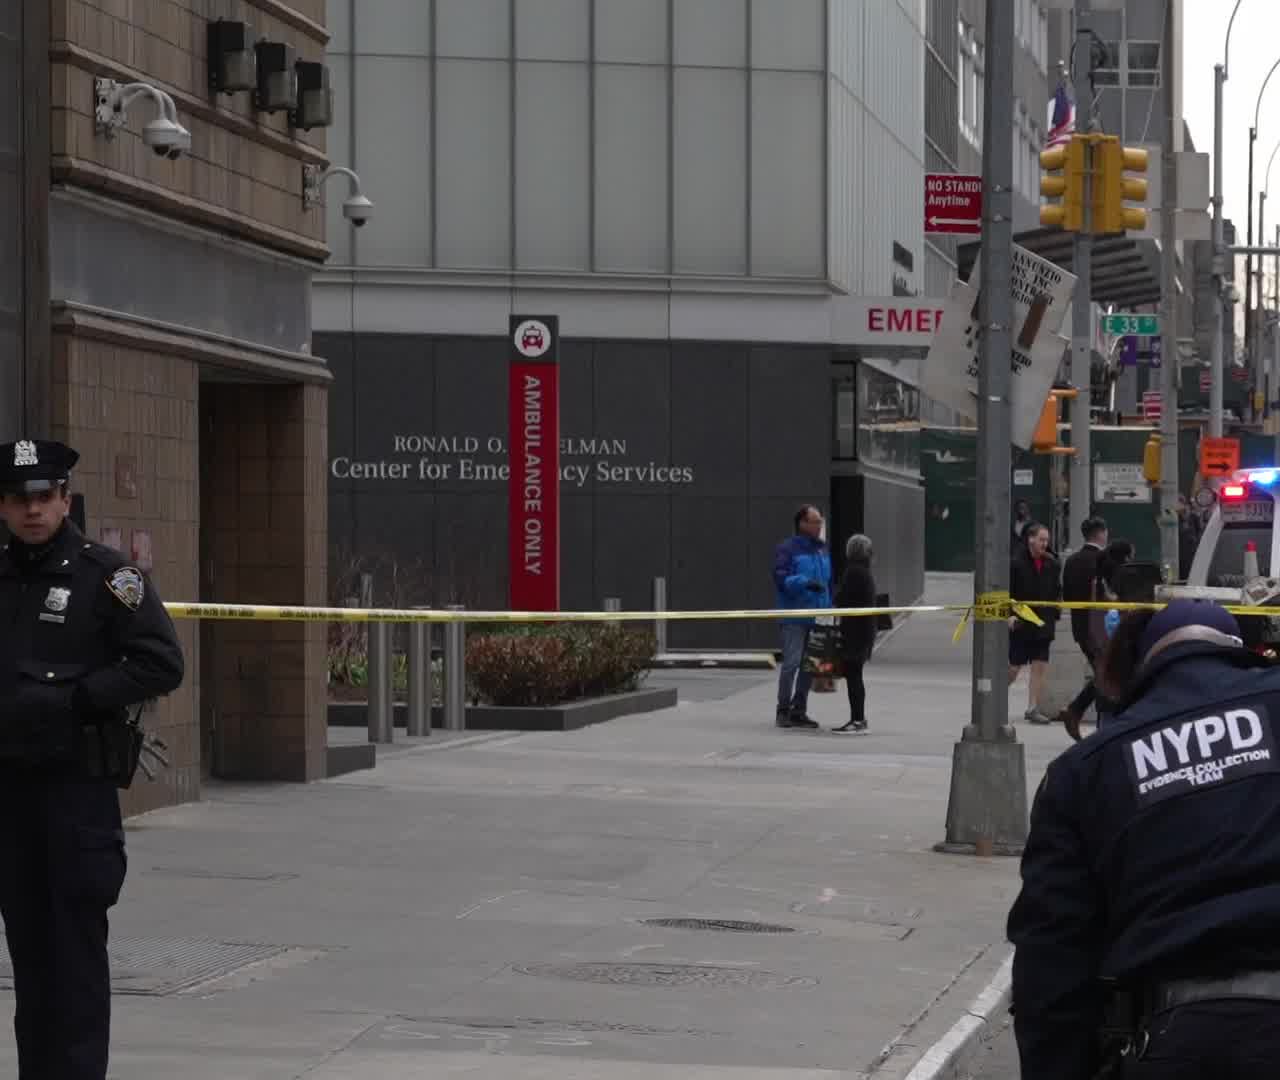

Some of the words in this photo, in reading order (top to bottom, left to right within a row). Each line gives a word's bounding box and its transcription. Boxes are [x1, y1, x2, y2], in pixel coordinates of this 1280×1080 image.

[928, 180, 942, 191] NO
[945, 180, 982, 193] STANDI
[928, 195, 970, 208] Anytime
[394, 436, 479, 453] RONALD
[487, 437, 507, 453] O.
[559, 438, 628, 455] ELMAN
[523, 375, 542, 512] AMBULANCE
[331, 457, 412, 479] Center
[418, 458, 450, 480] for
[458, 459, 589, 487] Emecy
[596, 461, 694, 484] Services
[523, 519, 542, 575] ONLY
[1131, 708, 1263, 779] NYPD
[1139, 766, 1193, 794] EVIDENCE
[1195, 749, 1271, 775] COLLECTION
[1186, 768, 1224, 786] TEAM
